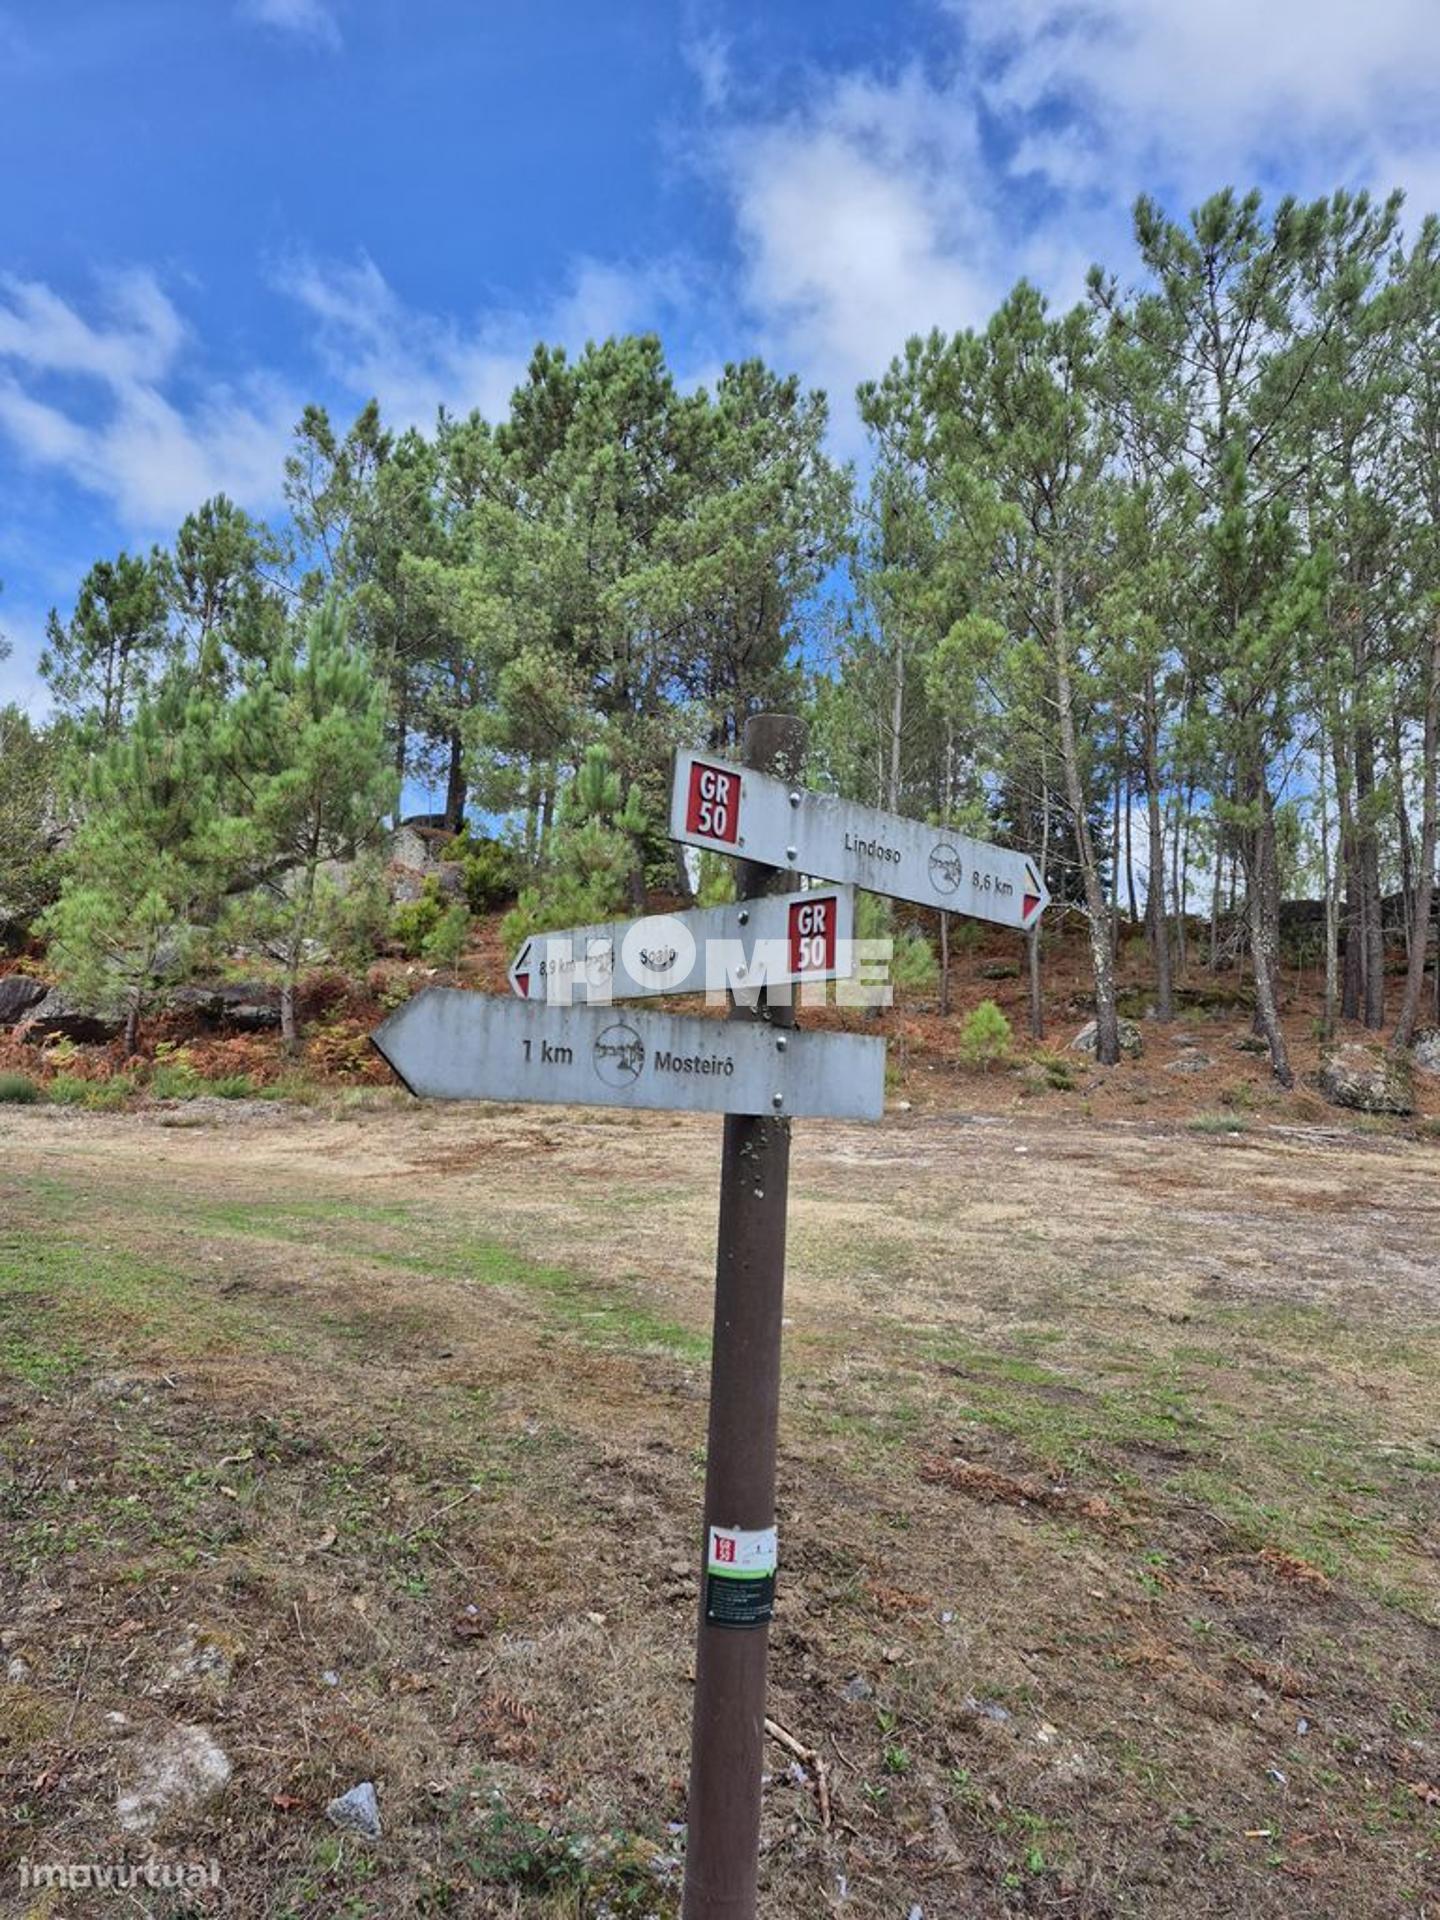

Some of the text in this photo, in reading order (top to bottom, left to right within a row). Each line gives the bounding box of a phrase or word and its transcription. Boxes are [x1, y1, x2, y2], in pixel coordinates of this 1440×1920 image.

[700, 769, 730, 805] GR
[698, 800, 727, 837] 50
[843, 832, 1014, 896] Lindoso 8,6 km
[797, 904, 826, 936] GR
[559, 957, 577, 973] km
[797, 934, 825, 969] 50
[522, 1039, 735, 1077] 1 km Mosteirô
